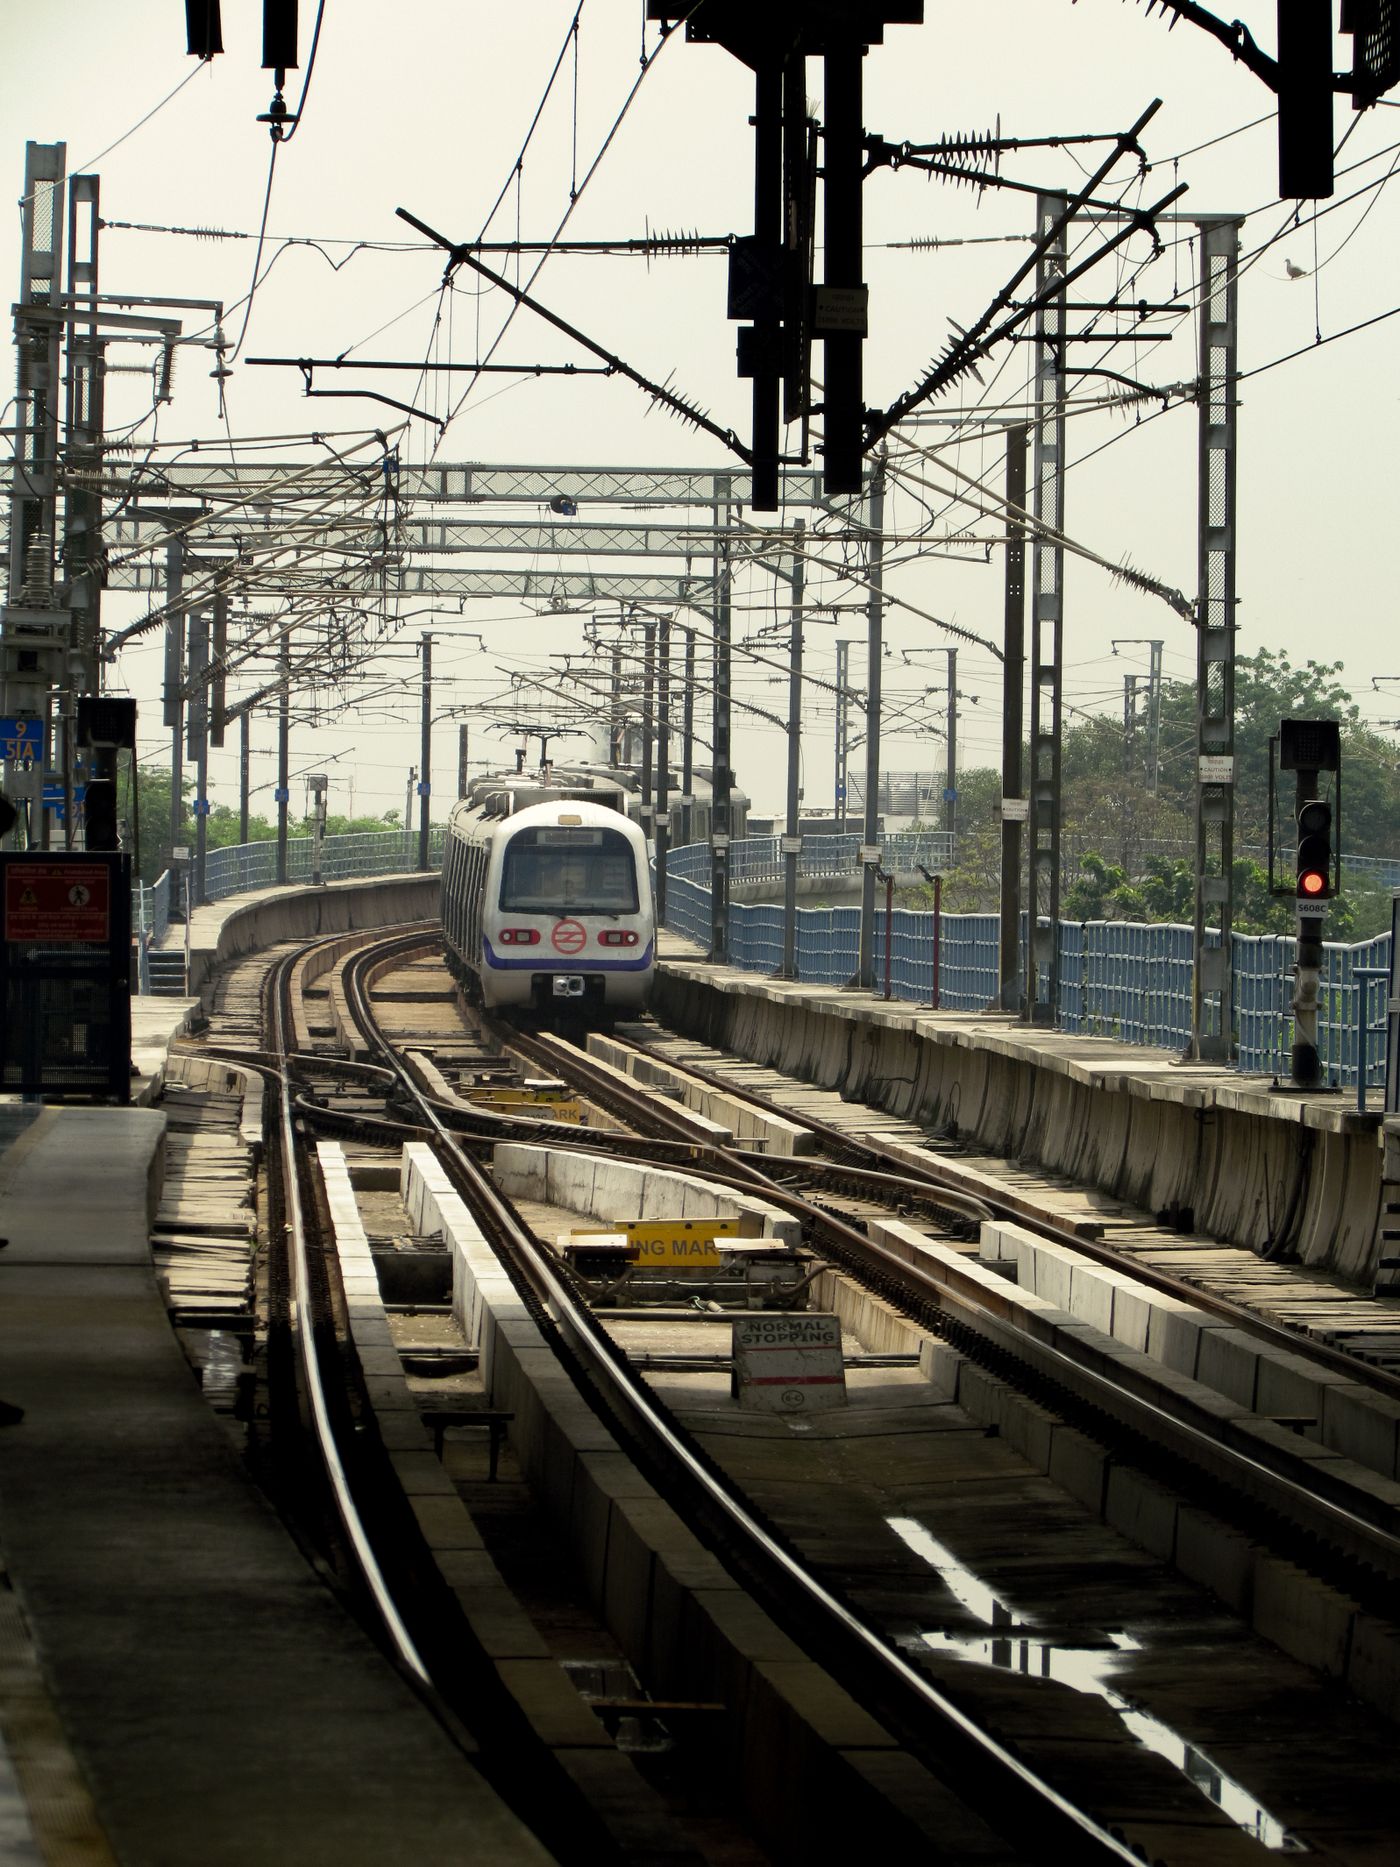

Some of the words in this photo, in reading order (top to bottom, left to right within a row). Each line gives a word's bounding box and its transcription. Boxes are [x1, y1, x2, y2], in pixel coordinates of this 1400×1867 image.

[15, 721, 28, 738] 9
[1298, 904, 1327, 912] S608C
[630, 1240, 665, 1255] ING
[672, 1240, 719, 1255] MAR
[749, 1321, 826, 1332] NORMAL
[741, 1331, 834, 1344] STOPPING
